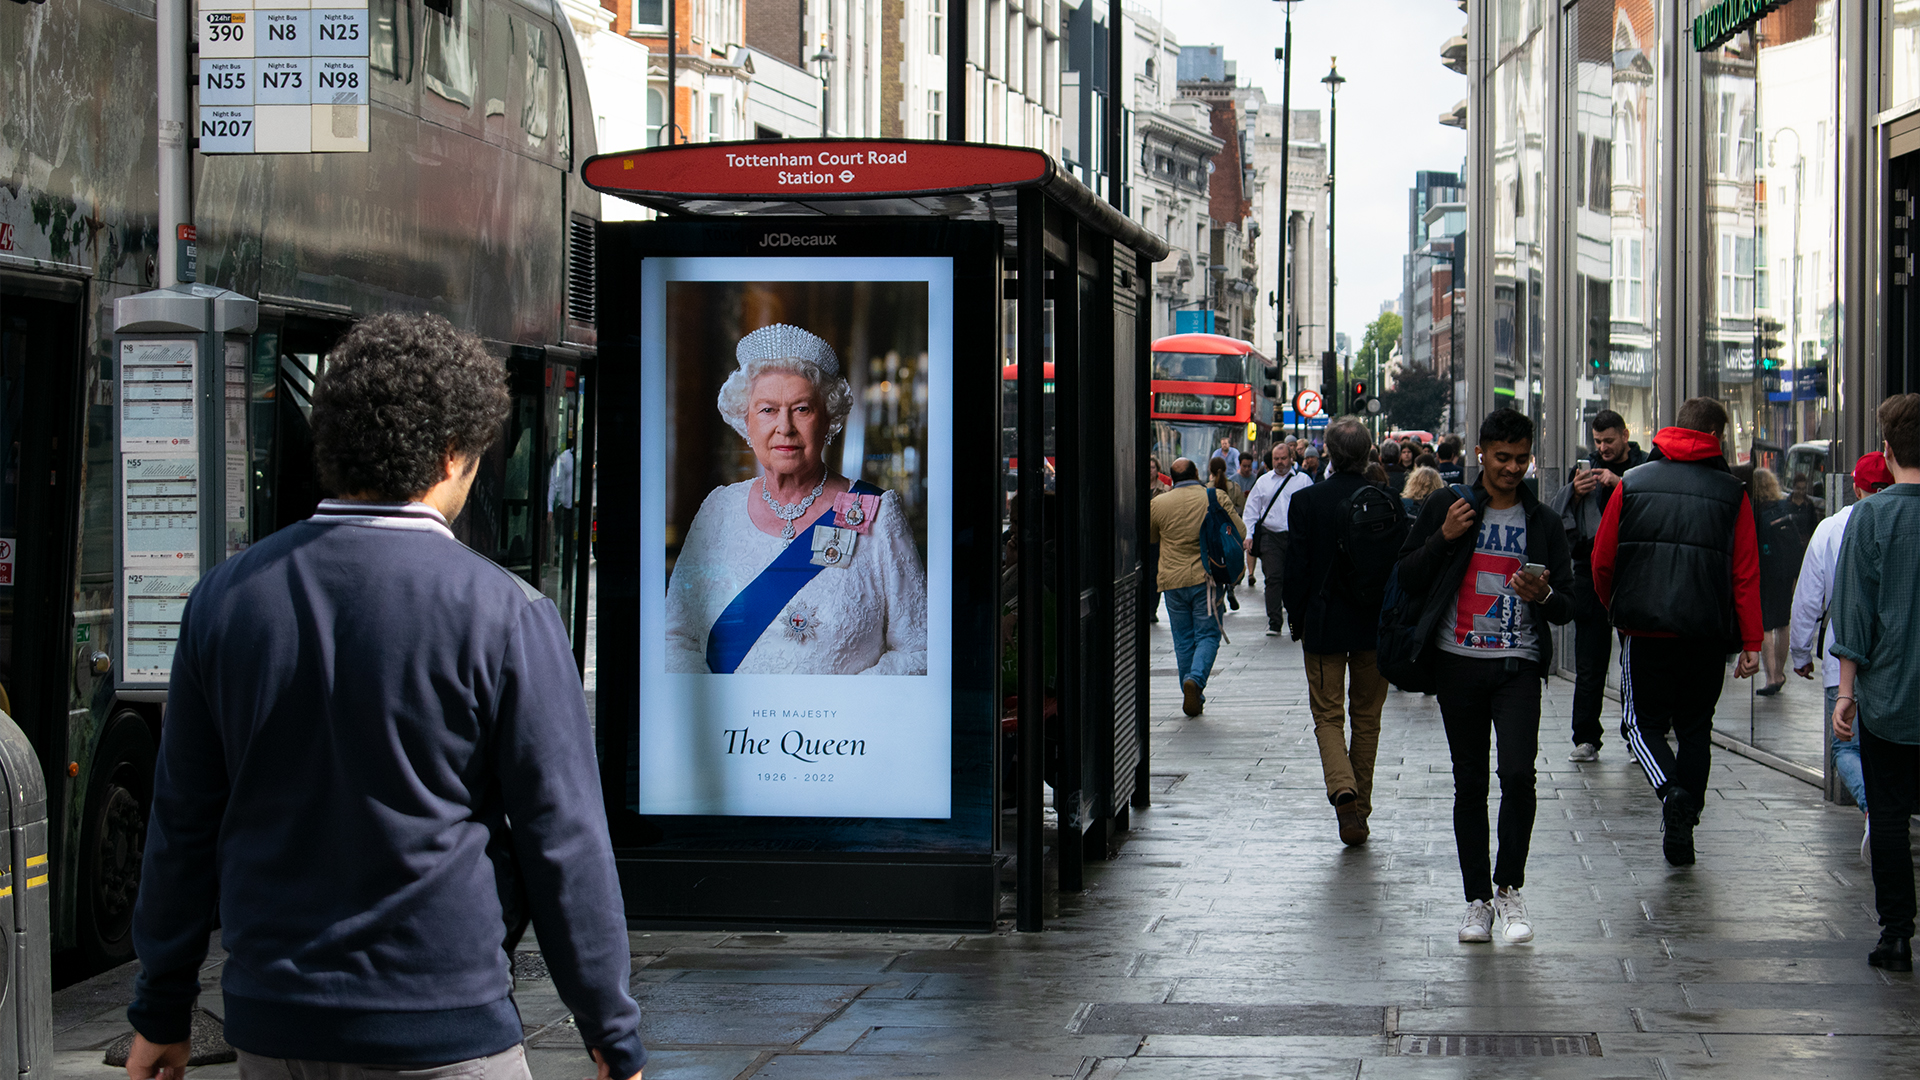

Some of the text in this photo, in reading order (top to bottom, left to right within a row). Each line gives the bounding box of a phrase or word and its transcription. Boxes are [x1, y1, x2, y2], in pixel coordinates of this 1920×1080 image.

[213, 14, 231, 22] 24hr
[209, 25, 244, 42] 390
[269, 24, 297, 41] N8
[319, 24, 359, 41] N25
[1693, 4, 1720, 52] UNITED
[268, 62, 284, 70] Night
[324, 62, 341, 70] Night
[207, 73, 246, 89] N55
[263, 72, 302, 88] N73
[319, 72, 359, 89] N98
[201, 120, 252, 137] N207
[726, 150, 907, 168] Tottenham Court Road
[778, 170, 834, 185] Station
[340, 195, 404, 246] KRAKEN
[759, 233, 837, 247] JCDecaux
[123, 344, 134, 352] N8
[1160, 398, 1231, 412] Oxford Circus 55
[127, 459, 142, 467] N55
[128, 575, 143, 583] N25
[752, 709, 838, 718] HER MAJESTY
[723, 726, 867, 763] The Queen
[758, 773, 787, 782] 1926
[804, 773, 835, 783] 2022
